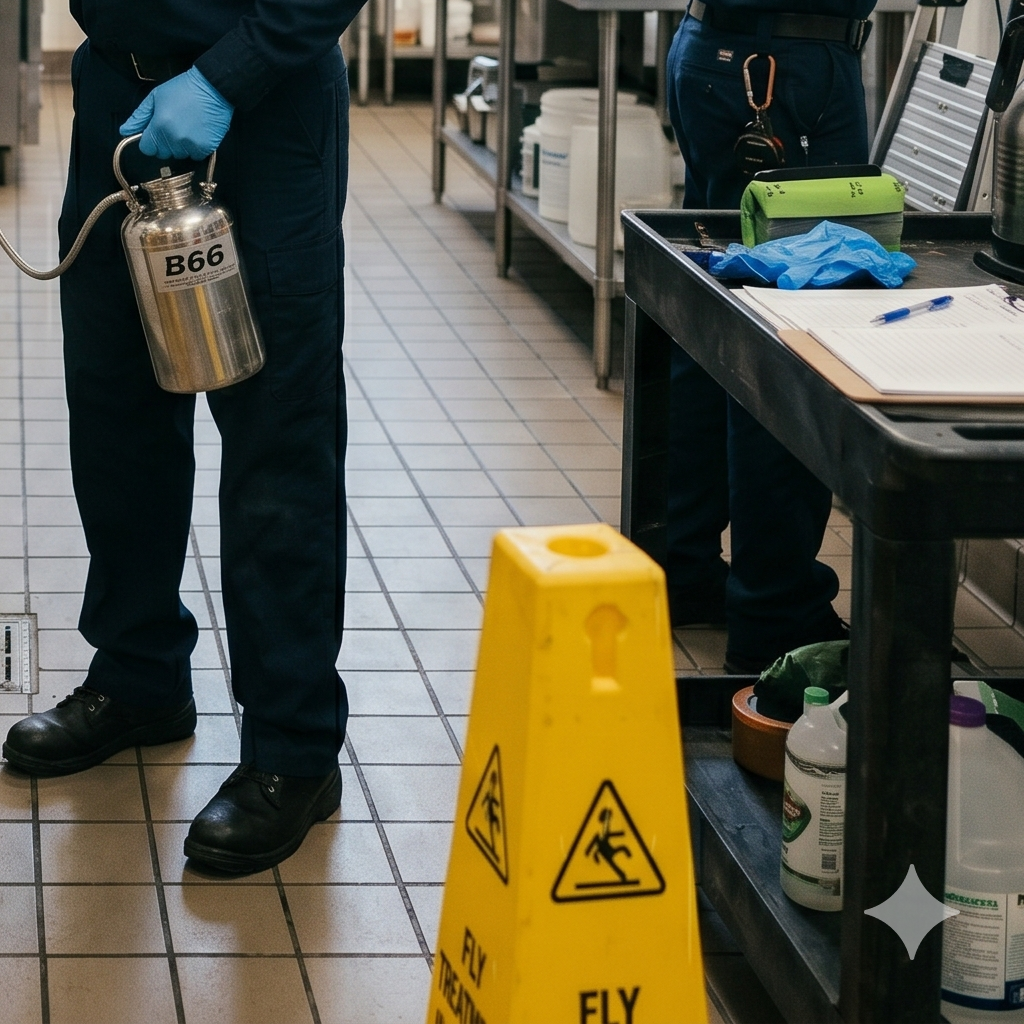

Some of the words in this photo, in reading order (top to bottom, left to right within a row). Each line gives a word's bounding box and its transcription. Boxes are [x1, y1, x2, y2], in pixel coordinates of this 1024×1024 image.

[164, 243, 225, 277] B66
[462, 926, 487, 989] FLY
[579, 986, 640, 1024] FLY
